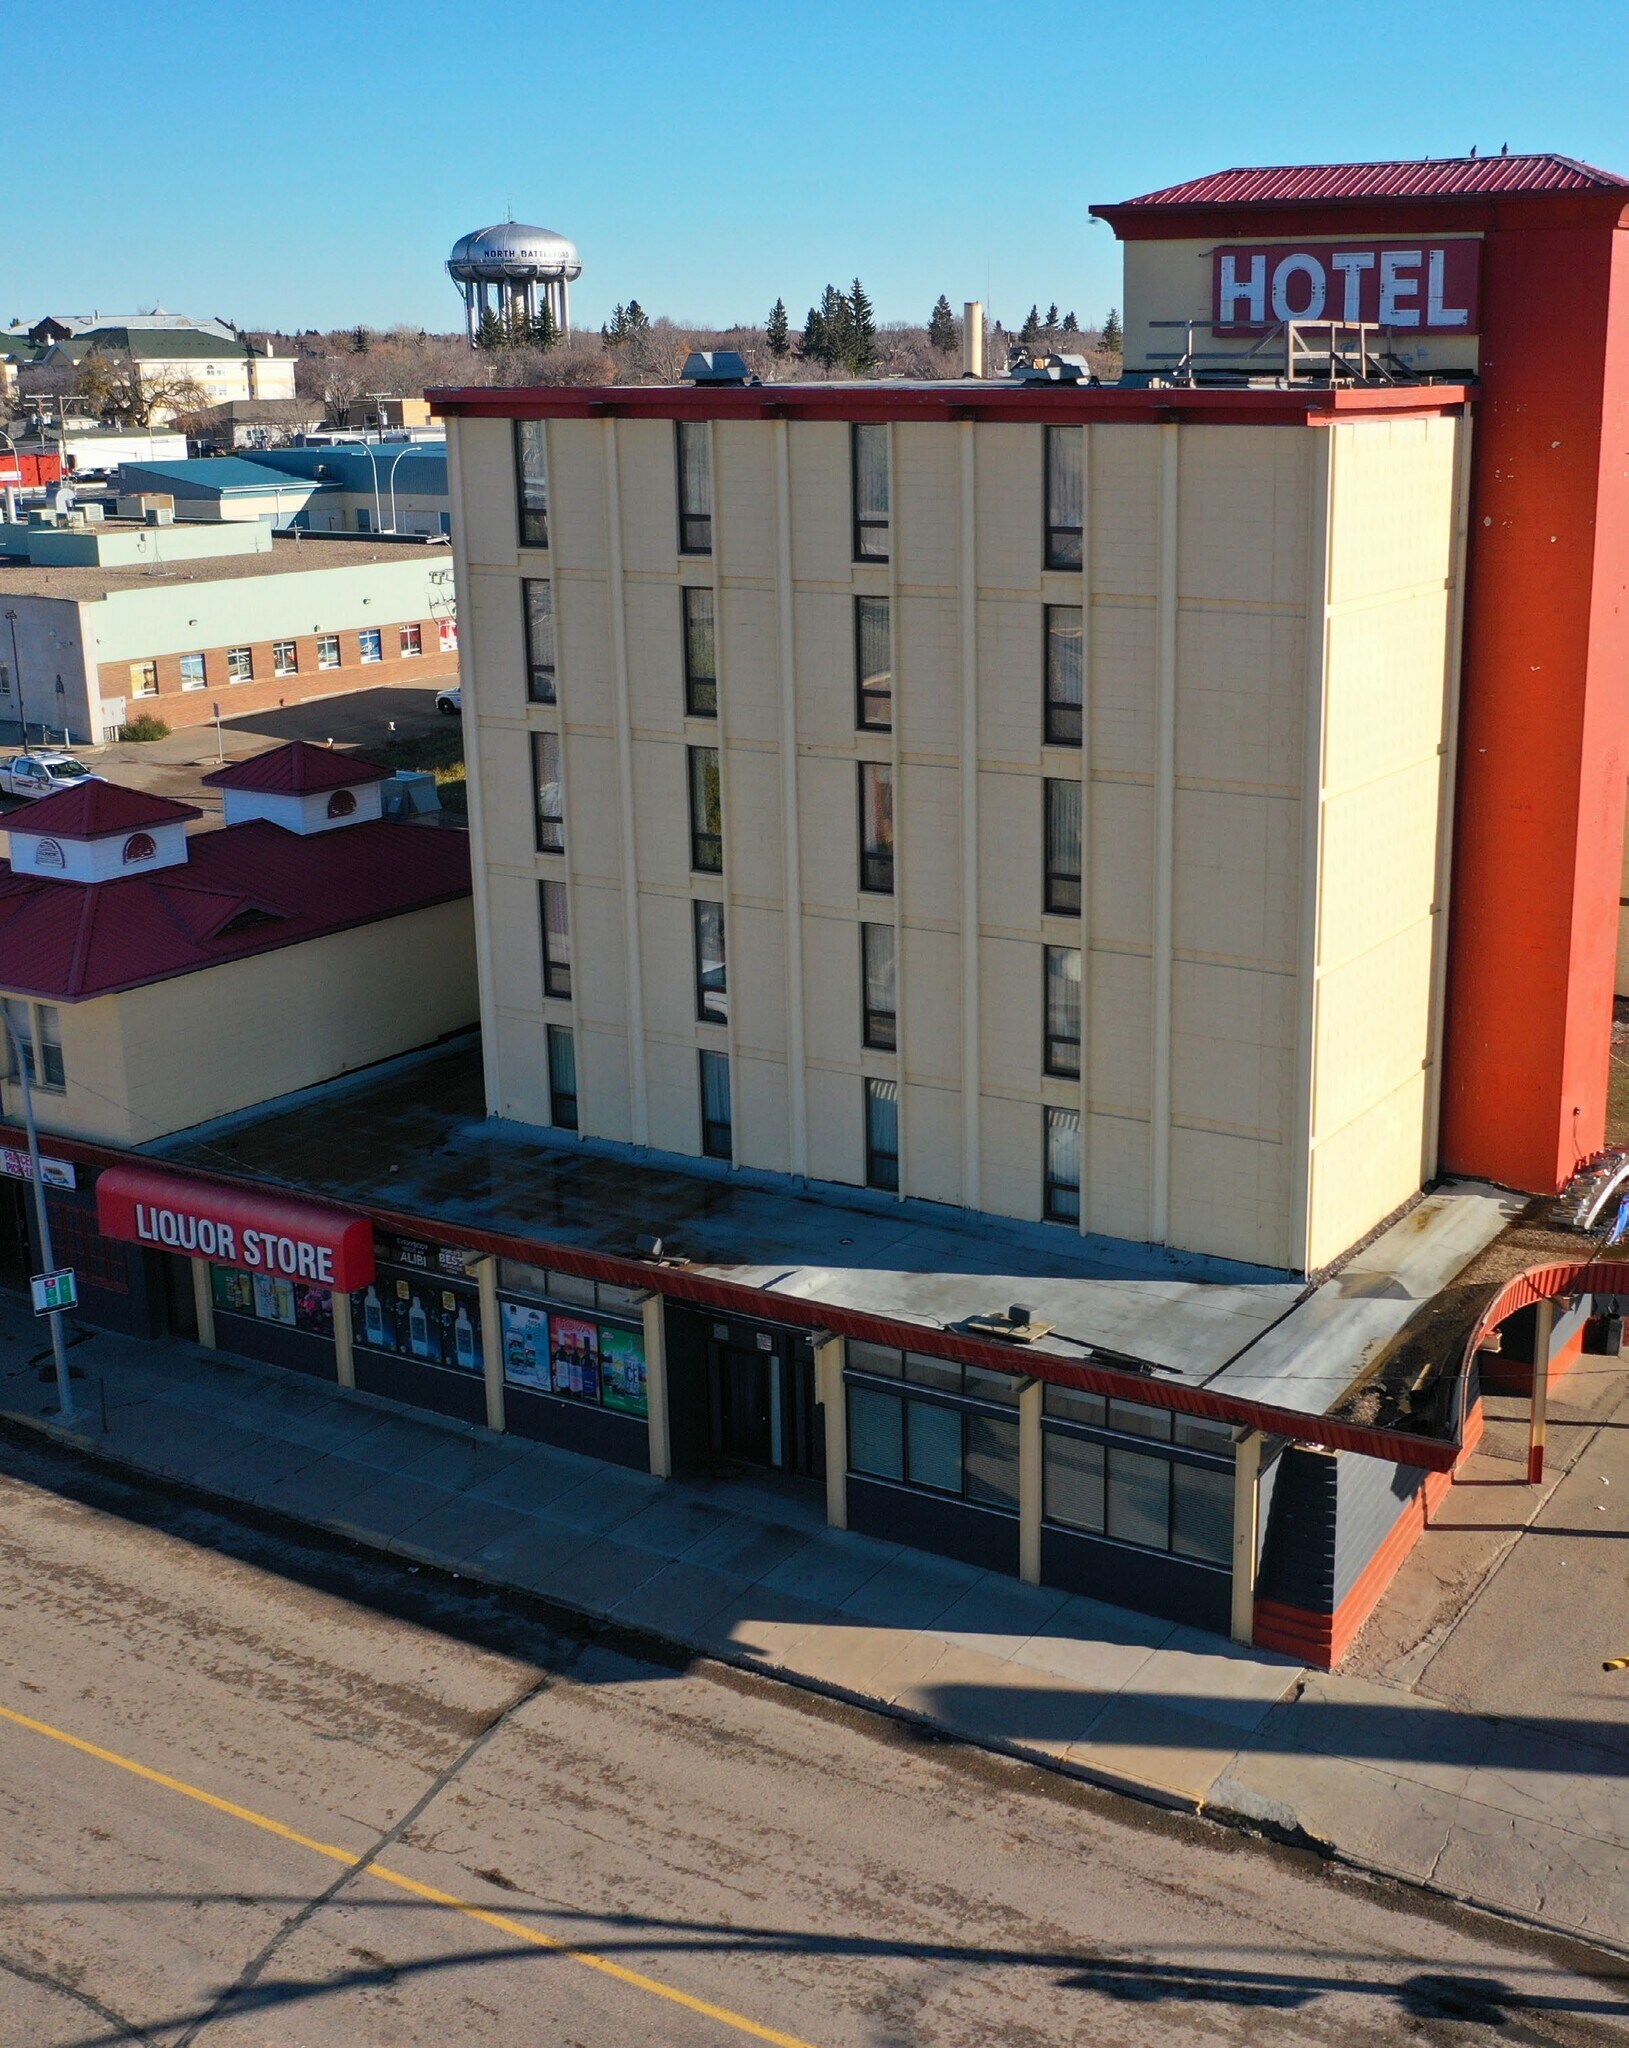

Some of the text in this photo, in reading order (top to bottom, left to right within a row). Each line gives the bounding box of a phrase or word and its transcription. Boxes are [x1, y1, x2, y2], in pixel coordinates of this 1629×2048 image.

[484, 250, 515, 258] NORTH
[1220, 250, 1468, 328] HOTEL
[6, 1162, 34, 1177] PICK-U
[136, 1204, 335, 1284] LIQUOR STORE
[400, 1251, 427, 1268] ALIBI
[439, 1253, 464, 1267] BEST
